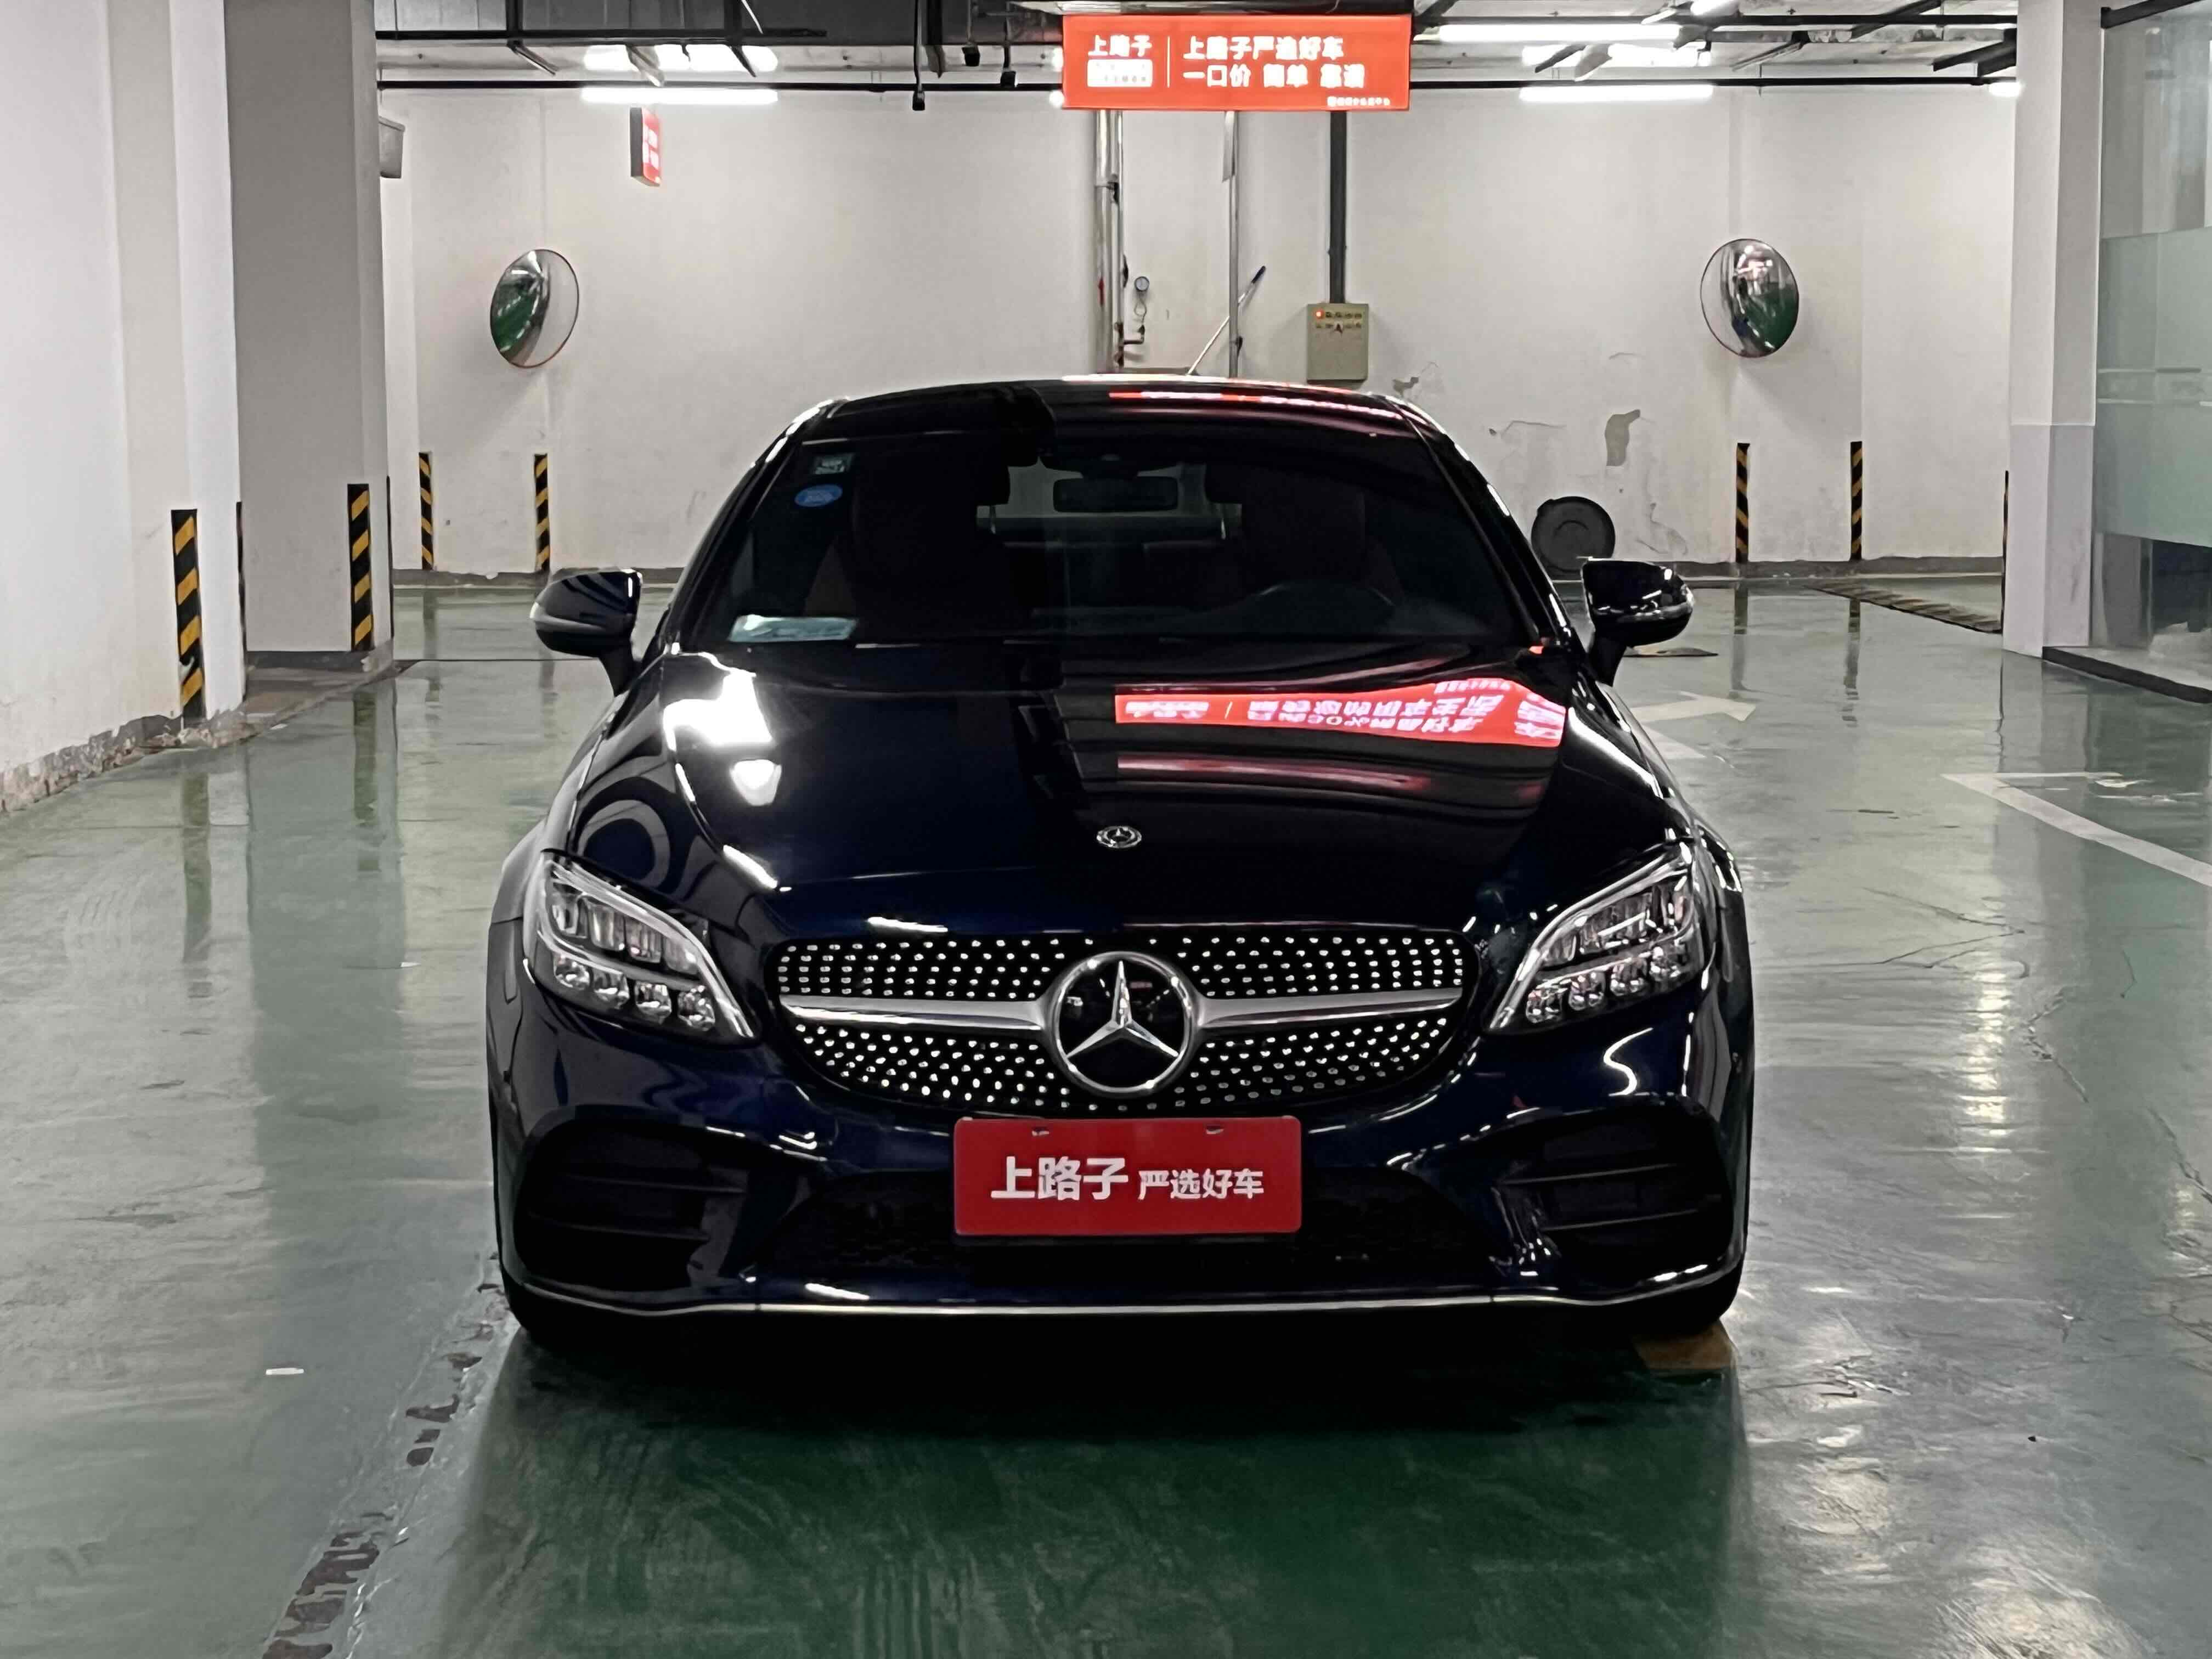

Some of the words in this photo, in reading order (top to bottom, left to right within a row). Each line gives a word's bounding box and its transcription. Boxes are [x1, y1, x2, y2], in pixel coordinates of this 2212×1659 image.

[1183, 64, 1251, 87] 一口价
[991, 1156, 1128, 1201] 上路子
[1138, 1169, 1264, 1200] 严选好车
